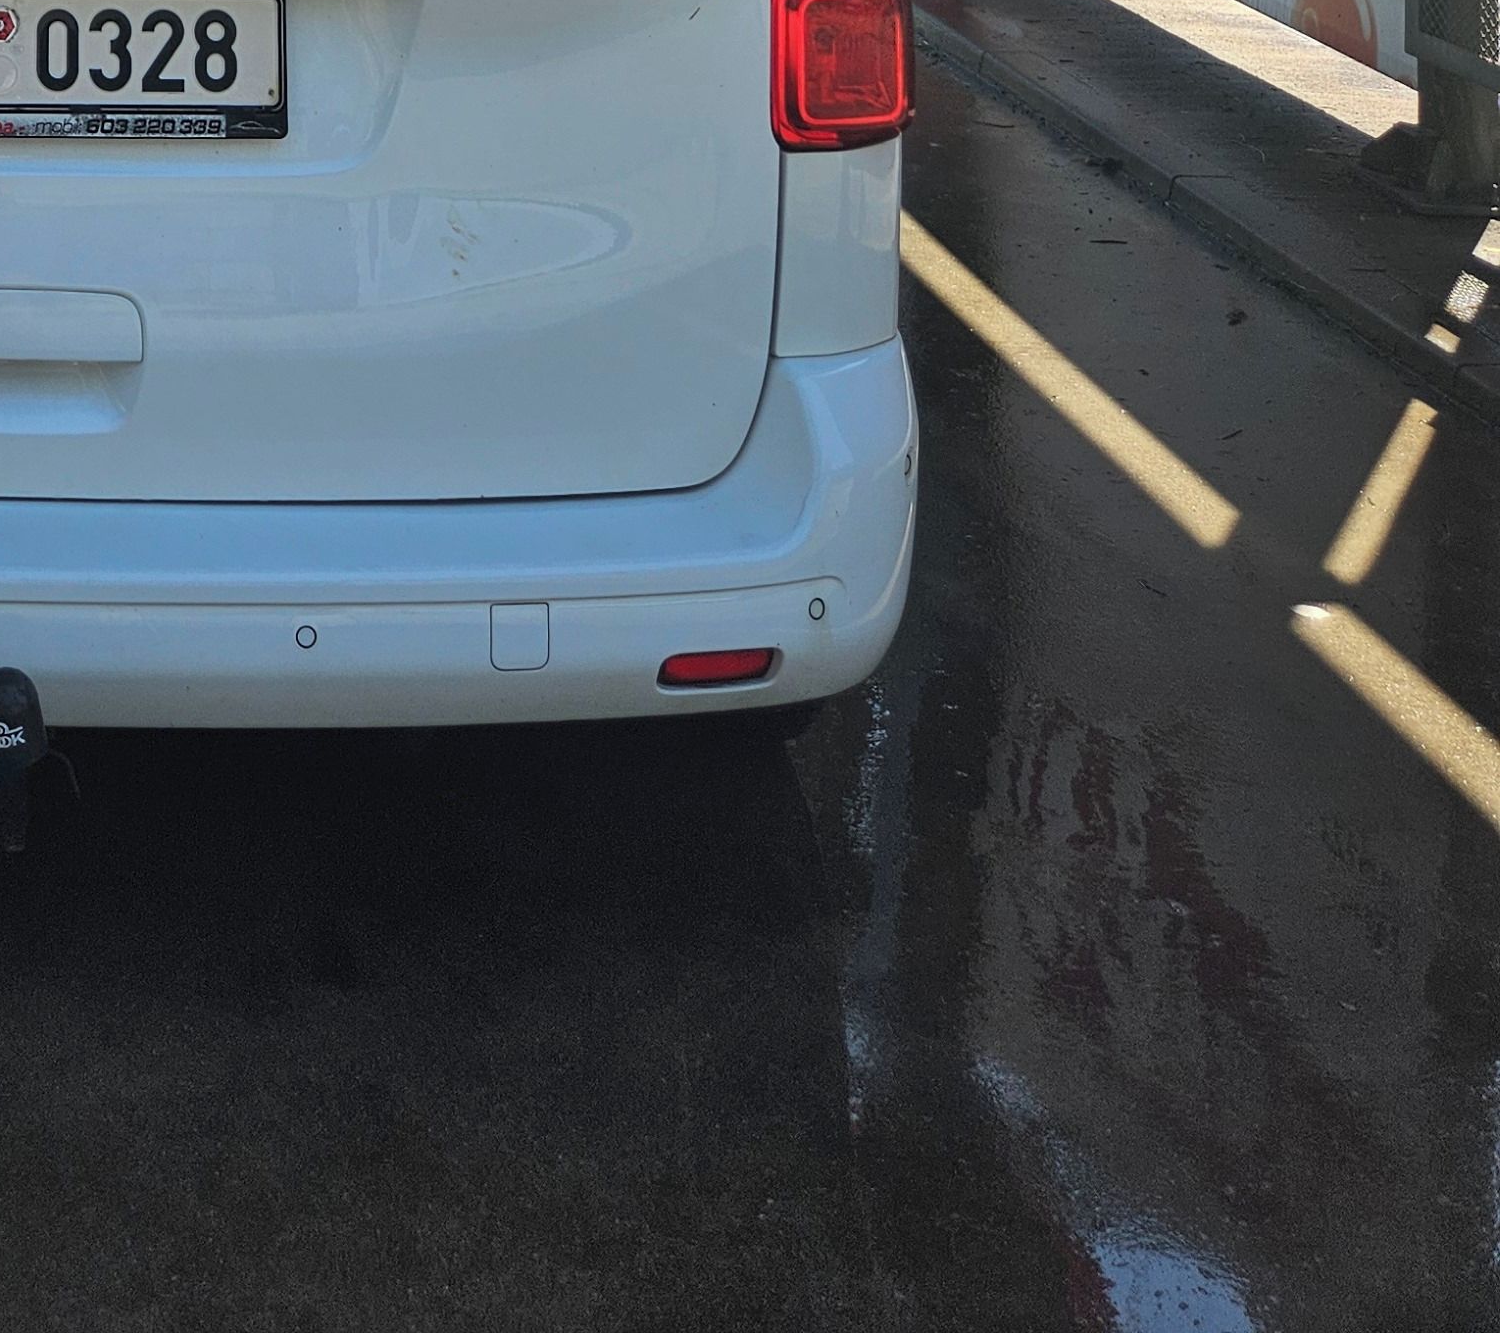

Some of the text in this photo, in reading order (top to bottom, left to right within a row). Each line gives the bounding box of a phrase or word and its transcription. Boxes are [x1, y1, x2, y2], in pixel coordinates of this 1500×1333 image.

[35, 7, 238, 94] 0328
[86, 118, 128, 134] 603
[133, 118, 176, 135] 220
